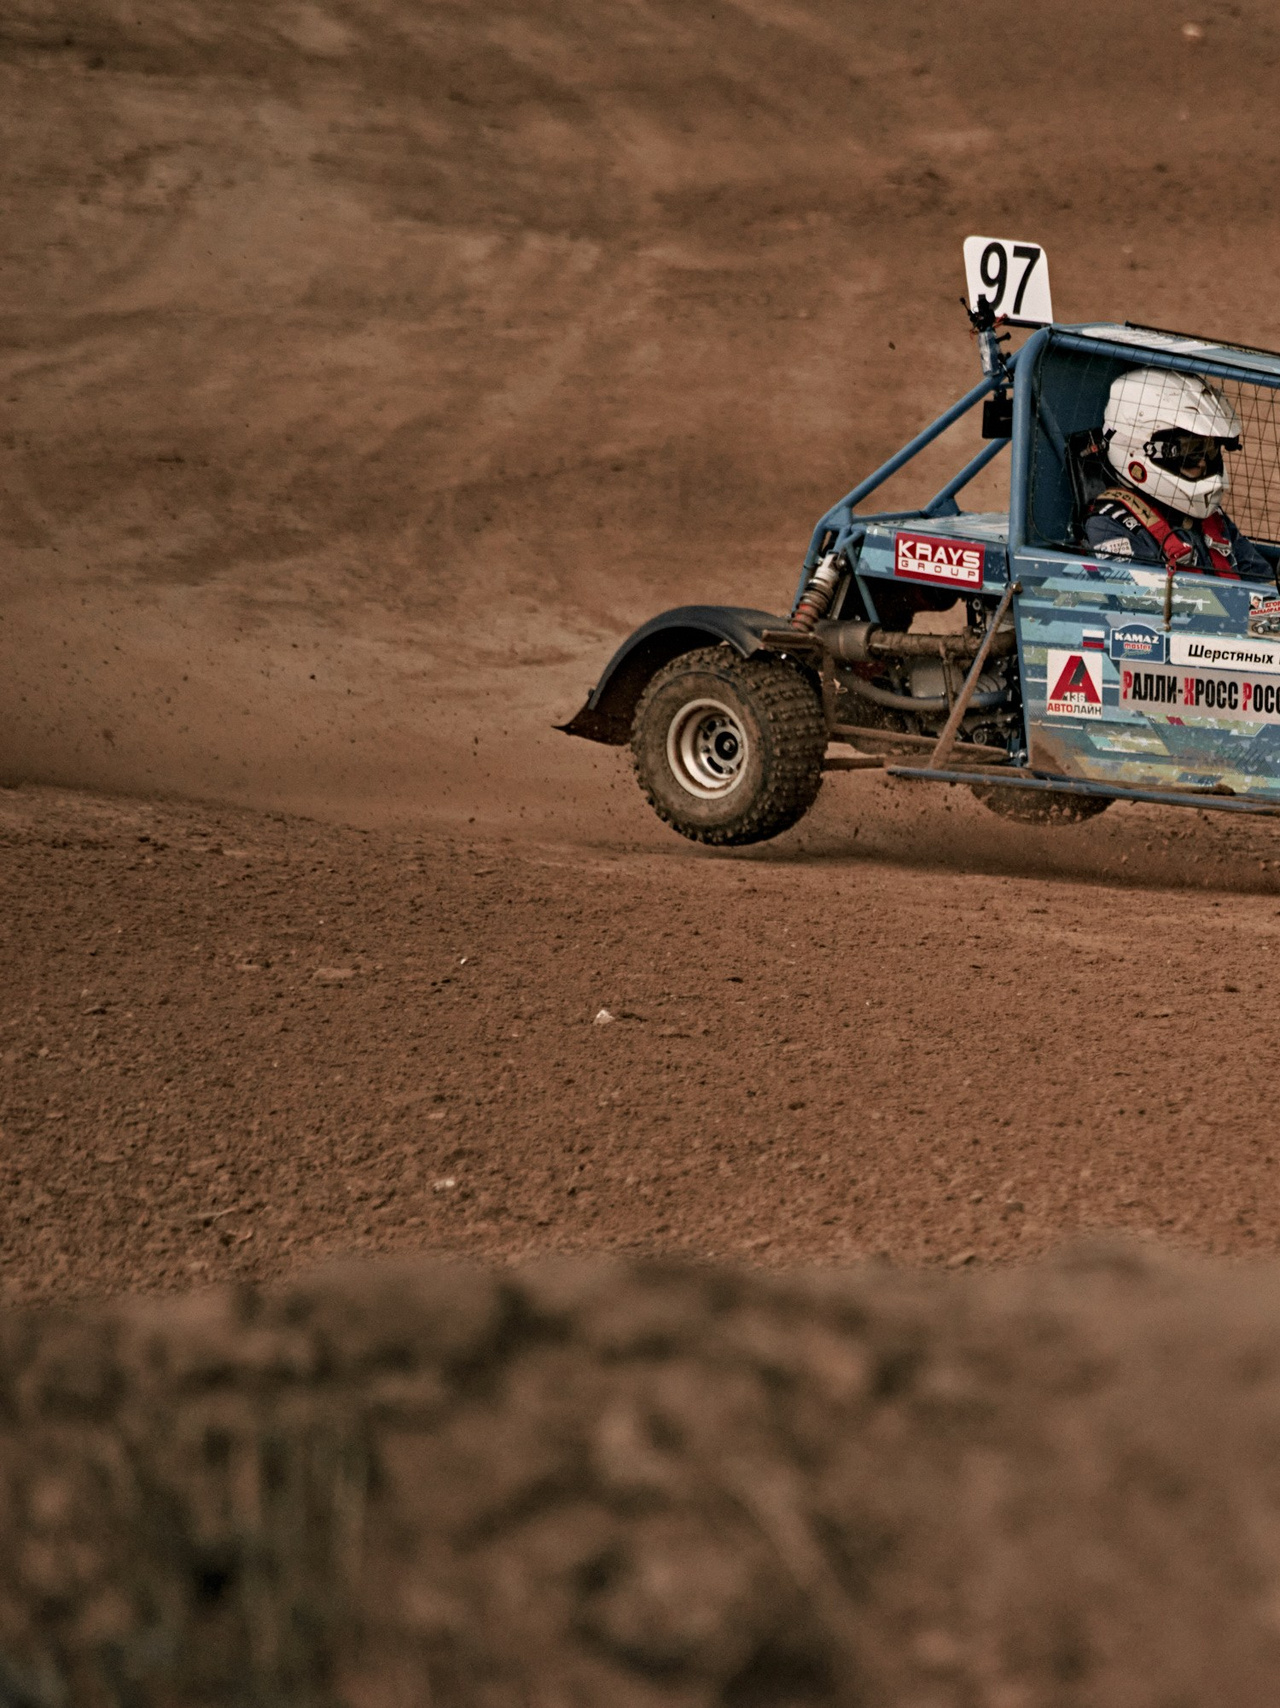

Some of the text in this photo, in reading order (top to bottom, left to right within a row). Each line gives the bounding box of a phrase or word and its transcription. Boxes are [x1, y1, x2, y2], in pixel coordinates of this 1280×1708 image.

[980, 241, 1041, 316] 97
[898, 539, 980, 570] KRAYS
[901, 559, 977, 579] GROUP
[1114, 631, 1160, 645] KAMAZ
[1124, 641, 1152, 651] master
[1188, 644, 1273, 665] Шерстяных
[1122, 670, 1239, 710] РАЛЛИ-КРОСС
[1047, 702, 1102, 715] АВТОЛАЙН
